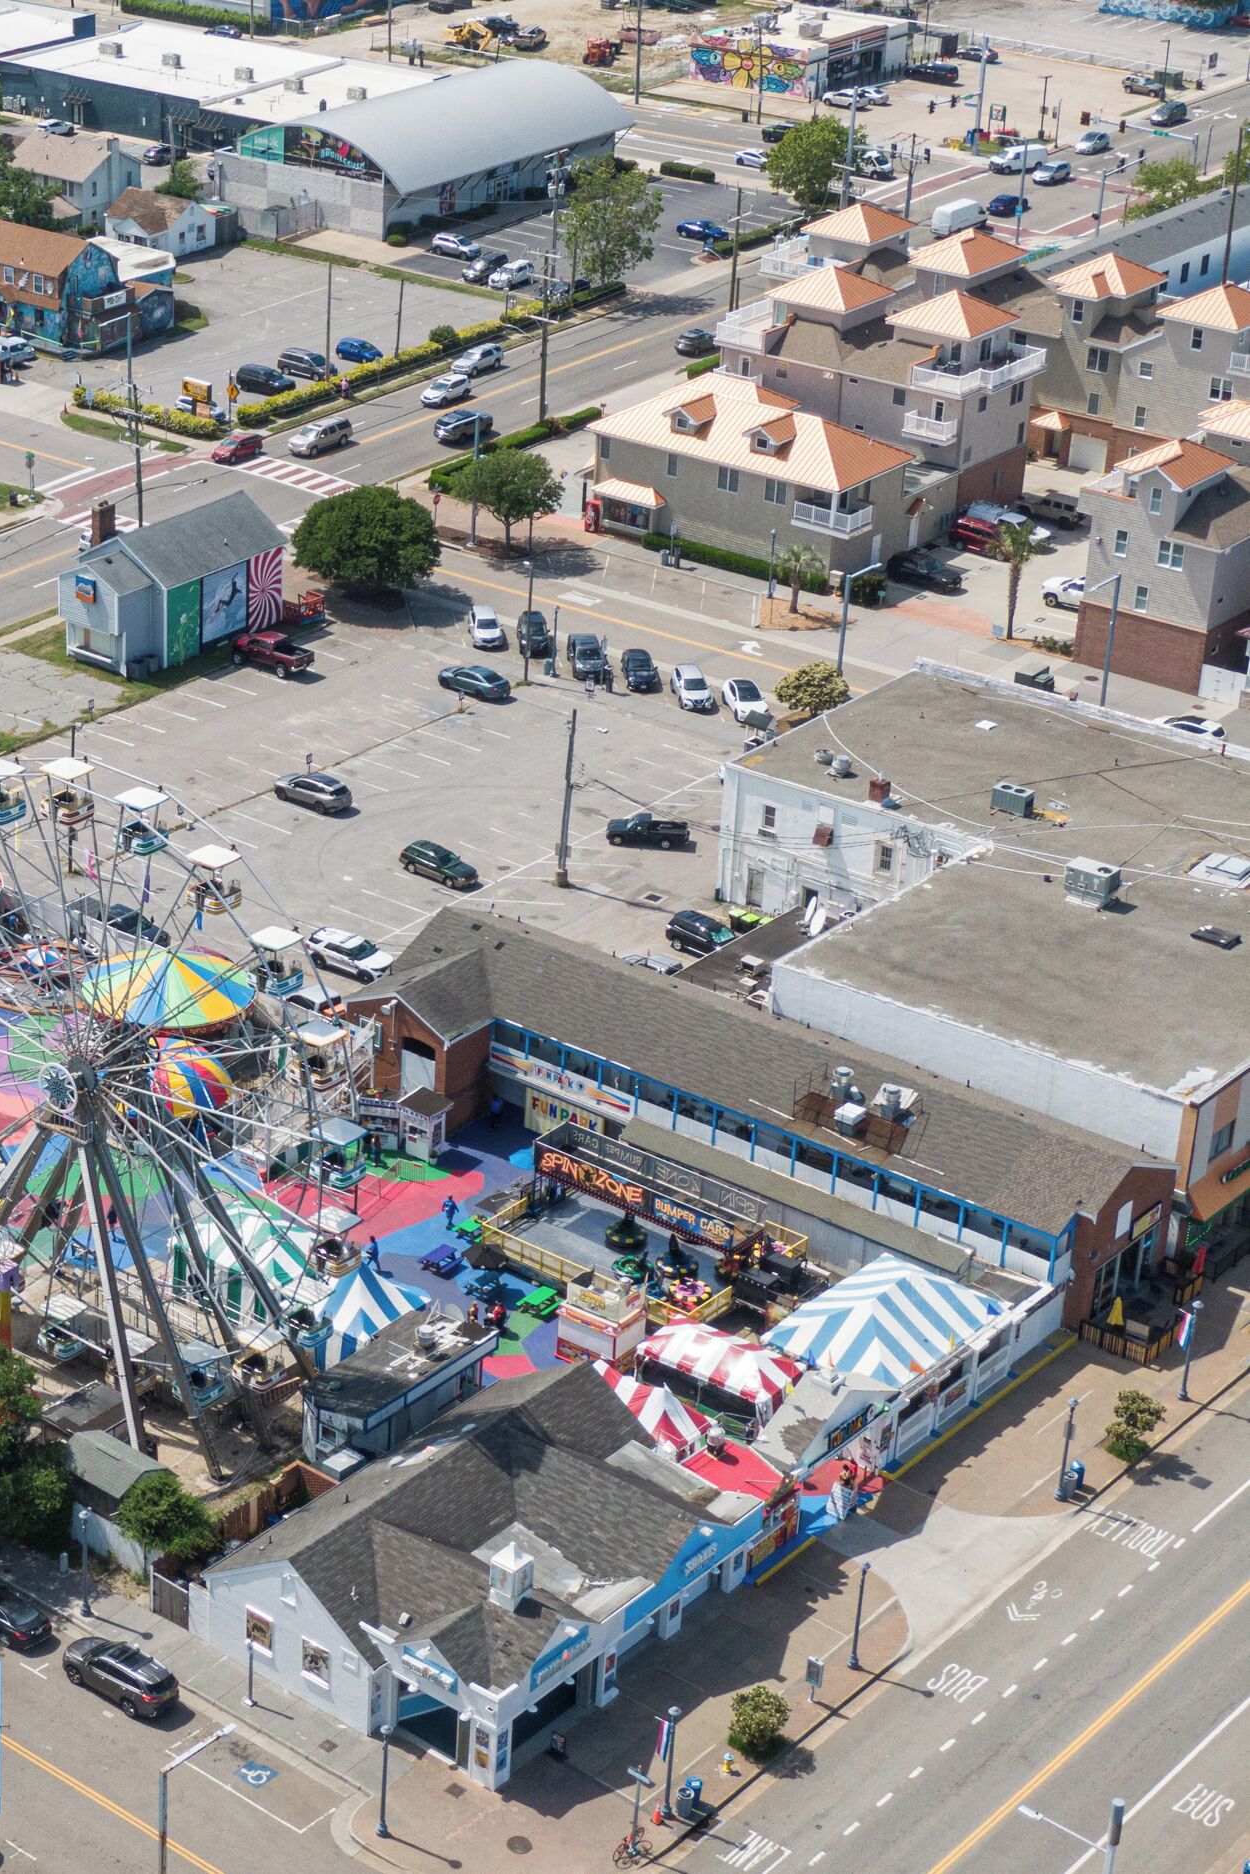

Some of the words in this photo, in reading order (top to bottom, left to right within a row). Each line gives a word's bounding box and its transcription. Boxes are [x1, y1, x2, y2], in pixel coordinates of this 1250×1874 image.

[532, 1096, 558, 1119] FUN
[560, 1108, 598, 1131] PARK
[540, 1152, 579, 1181] SPIN
[595, 1168, 644, 1204] ZONE
[654, 1199, 697, 1226] BUMPER
[699, 1217, 732, 1241] CARS
[1084, 1510, 1176, 1560] TROLLEY
[926, 1663, 989, 1704] BUS
[1171, 1783, 1236, 1828] BUS
[715, 1829, 793, 1874] LANE
